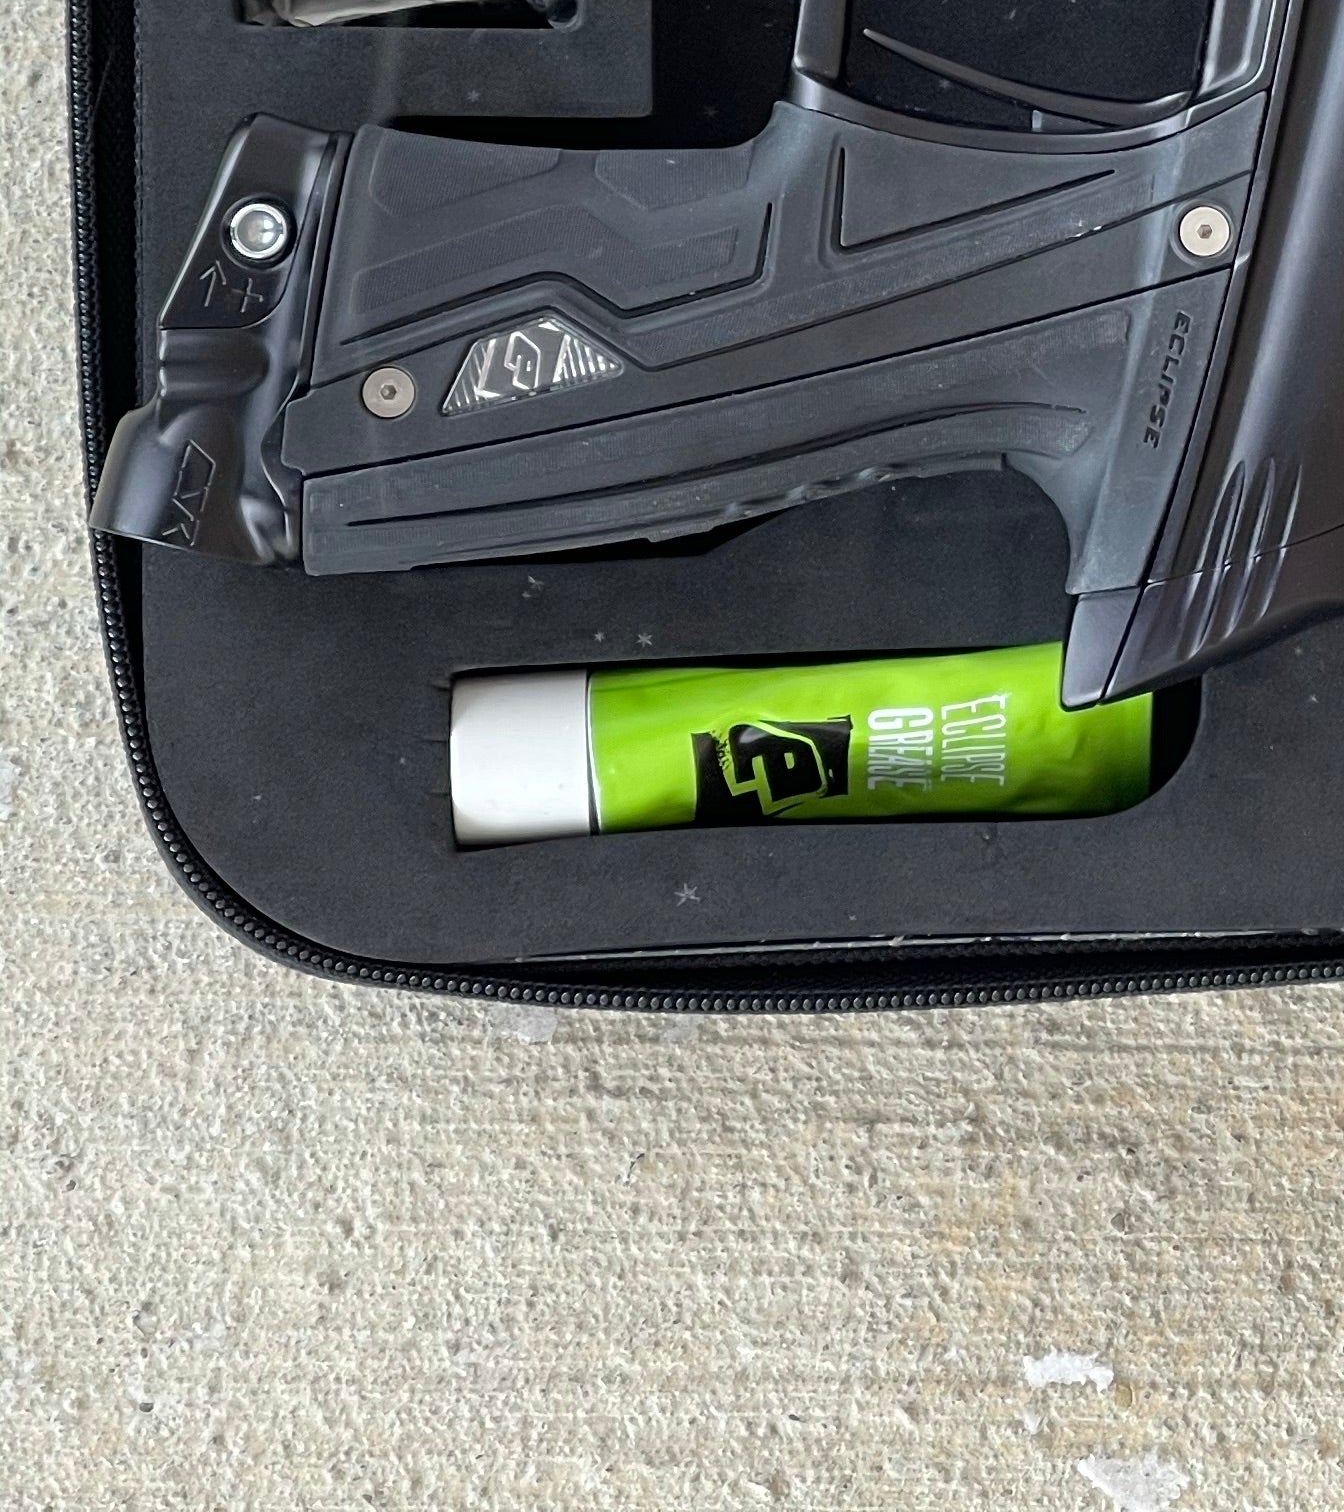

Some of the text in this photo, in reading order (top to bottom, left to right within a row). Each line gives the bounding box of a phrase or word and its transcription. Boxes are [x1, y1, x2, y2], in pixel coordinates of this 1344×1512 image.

[1143, 310, 1193, 449] ECLIPSE
[866, 707, 934, 793] GREASE
[940, 693, 1009, 787] ECLIPSE
